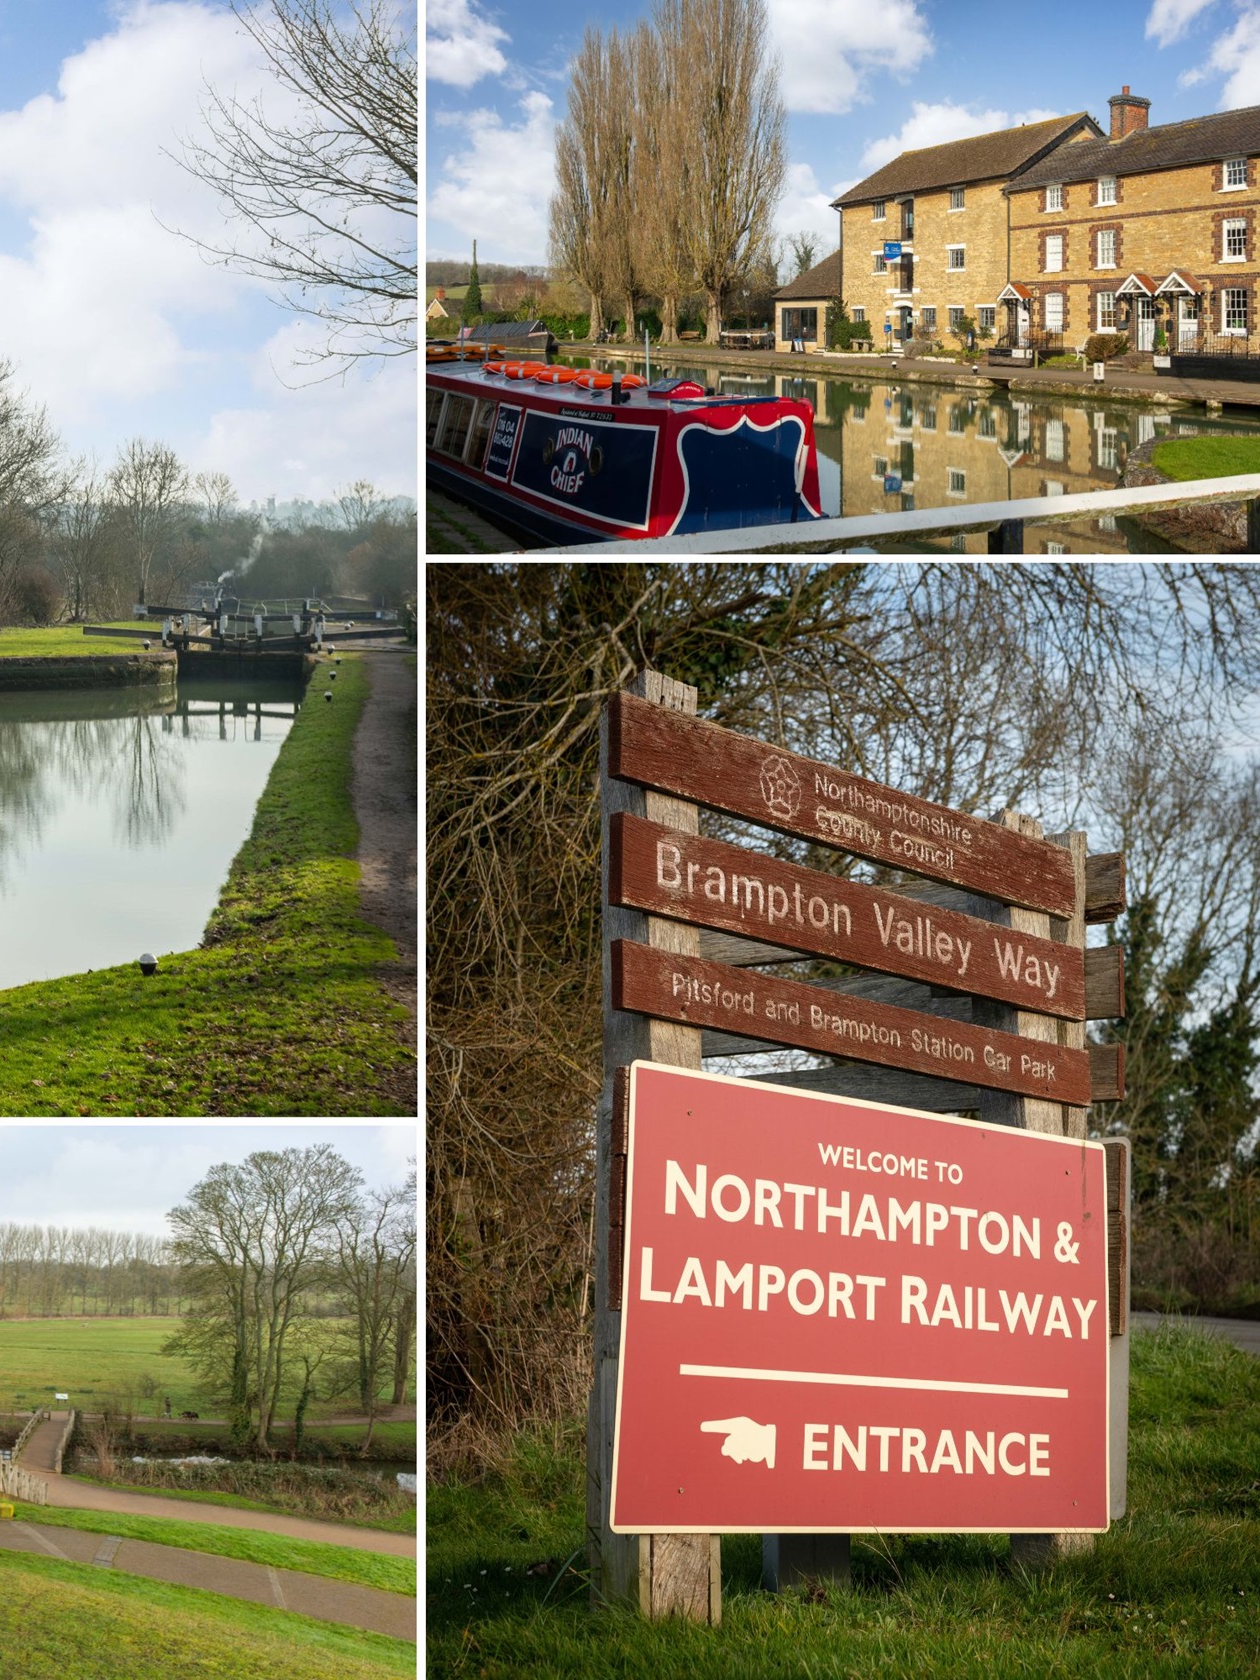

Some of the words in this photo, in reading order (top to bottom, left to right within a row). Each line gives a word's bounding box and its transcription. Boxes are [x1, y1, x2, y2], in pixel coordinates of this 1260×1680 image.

[554, 426, 594, 460] INDIAN
[550, 465, 585, 493] CHIEF
[814, 772, 973, 846] Northamptonshire
[815, 805, 881, 849] County
[889, 829, 955, 870] Council
[656, 840, 852, 936] Brampton
[873, 902, 972, 977] Valley
[994, 937, 1060, 999] Way
[672, 972, 755, 1016] Pitsford
[765, 999, 800, 1026] and
[810, 1004, 901, 1048] Brampton
[911, 1028, 975, 1064] Station
[983, 1045, 1012, 1073] Car
[1021, 1054, 1057, 1082] Park
[818, 1142, 929, 1181] WELCOME
[935, 1160, 964, 1186] TO
[664, 1159, 1042, 1260] NORTHAMPTON
[1053, 1221, 1081, 1265] &
[639, 1246, 887, 1321] LAMPORT
[900, 1274, 1098, 1341] RAILWAY
[802, 1423, 1051, 1477] ENTRANCE
